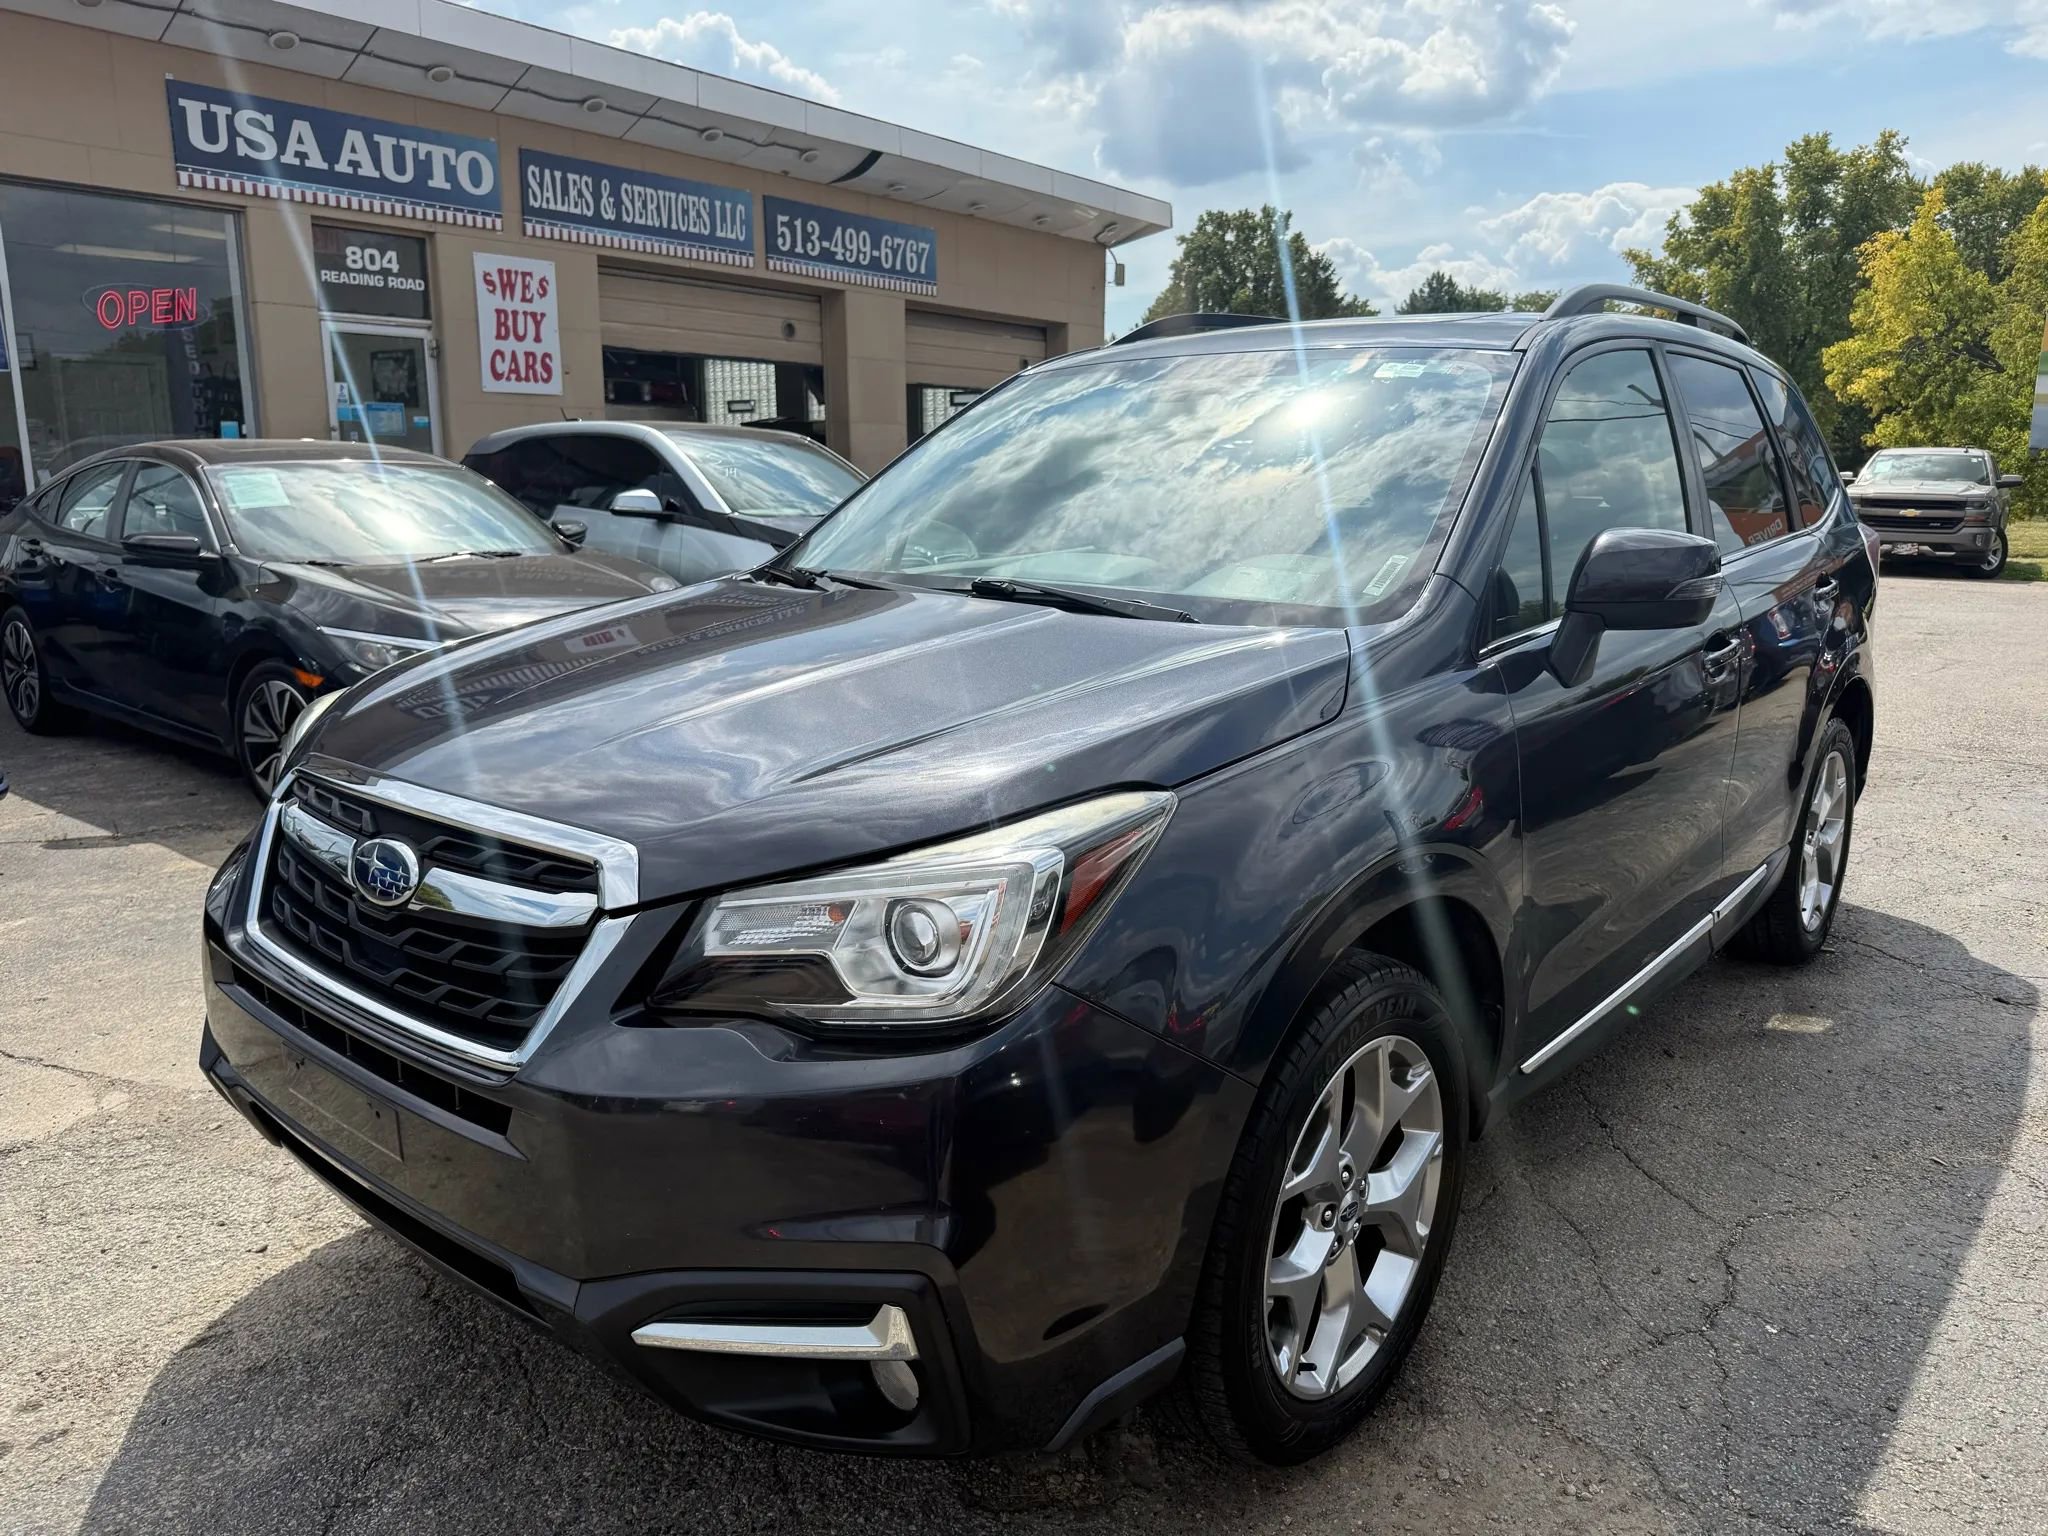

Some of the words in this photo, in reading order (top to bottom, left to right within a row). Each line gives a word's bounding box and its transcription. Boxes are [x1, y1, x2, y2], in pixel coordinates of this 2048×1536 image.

[178, 98, 329, 170] USA
[334, 128, 495, 196] AUTO
[527, 164, 594, 217] SALES
[600, 178, 616, 221] &
[620, 182, 710, 236] SERVICES
[715, 200, 746, 242] LLC
[345, 246, 400, 273] 804
[776, 214, 930, 274] 513-499-6767
[320, 269, 385, 287] READING
[388, 276, 425, 291] ROAD
[97, 287, 197, 329] OPEN
[494, 308, 547, 344] BUY
[490, 348, 553, 384] CARS
